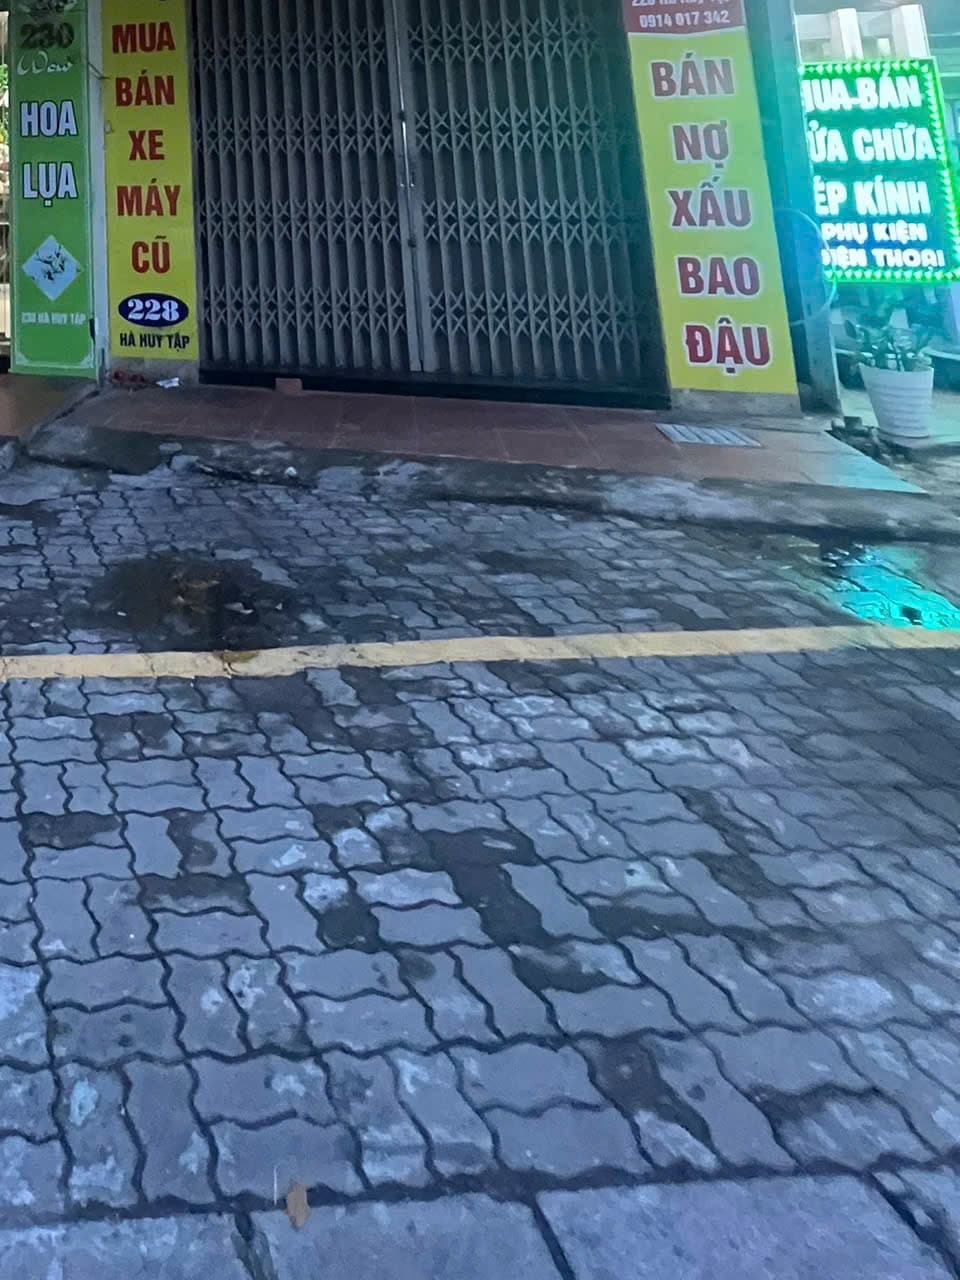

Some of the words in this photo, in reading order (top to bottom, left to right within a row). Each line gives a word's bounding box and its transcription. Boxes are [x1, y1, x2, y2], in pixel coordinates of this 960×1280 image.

[111, 22, 176, 54] MUA
[640, 14, 672, 28] 0914
[675, 11, 700, 26] 017
[703, 10, 731, 24] 342
[115, 70, 175, 107] BÁN
[650, 52, 735, 97] BÁN
[20, 100, 78, 137] HOA
[128, 130, 165, 161] XE
[672, 120, 730, 168] NỢ
[807, 120, 849, 163] ỬA
[852, 122, 937, 161] CHỮA
[22, 162, 78, 207] LỤA
[116, 178, 182, 217] MÁY
[668, 176, 752, 228] XẤU
[853, 175, 932, 216] KÍNH
[821, 222, 869, 245] PHỤ
[872, 219, 928, 245] KIỆN
[131, 235, 171, 274] CŨ
[871, 248, 946, 272] THOẠI
[677, 256, 761, 296] BAO
[127, 298, 180, 321] 228
[120, 332, 136, 348] HÀ
[139, 333, 162, 349] HUY
[167, 333, 190, 352] TẬP
[685, 317, 771, 374] ĐẬU
